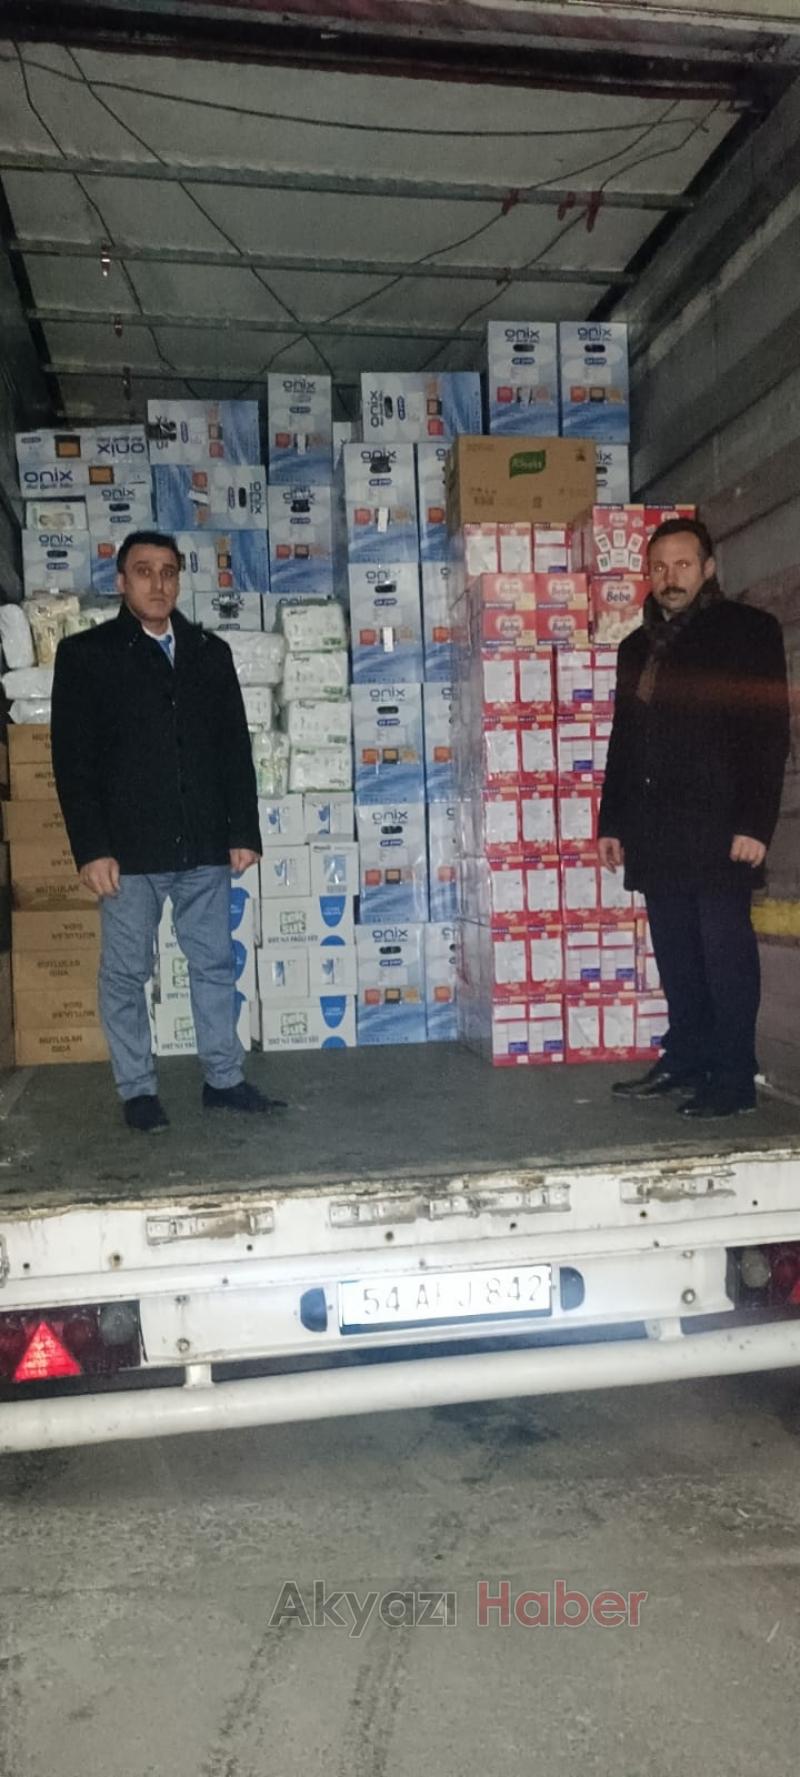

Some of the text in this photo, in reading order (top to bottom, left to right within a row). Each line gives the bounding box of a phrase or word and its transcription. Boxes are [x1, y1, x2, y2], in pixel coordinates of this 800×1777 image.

[505, 327, 540, 338] onix
[577, 326, 612, 337] onix
[282, 378, 316, 390] onix
[370, 390, 379, 427] onix
[24, 467, 73, 483] onix
[102, 486, 136, 497] onix
[38, 533, 73, 543] onix
[606, 591, 631, 602] Bebe
[369, 686, 406, 697] onix
[372, 808, 408, 820] onix
[372, 927, 408, 938] onix
[363, 1274, 542, 1315] 54 AJ 842
